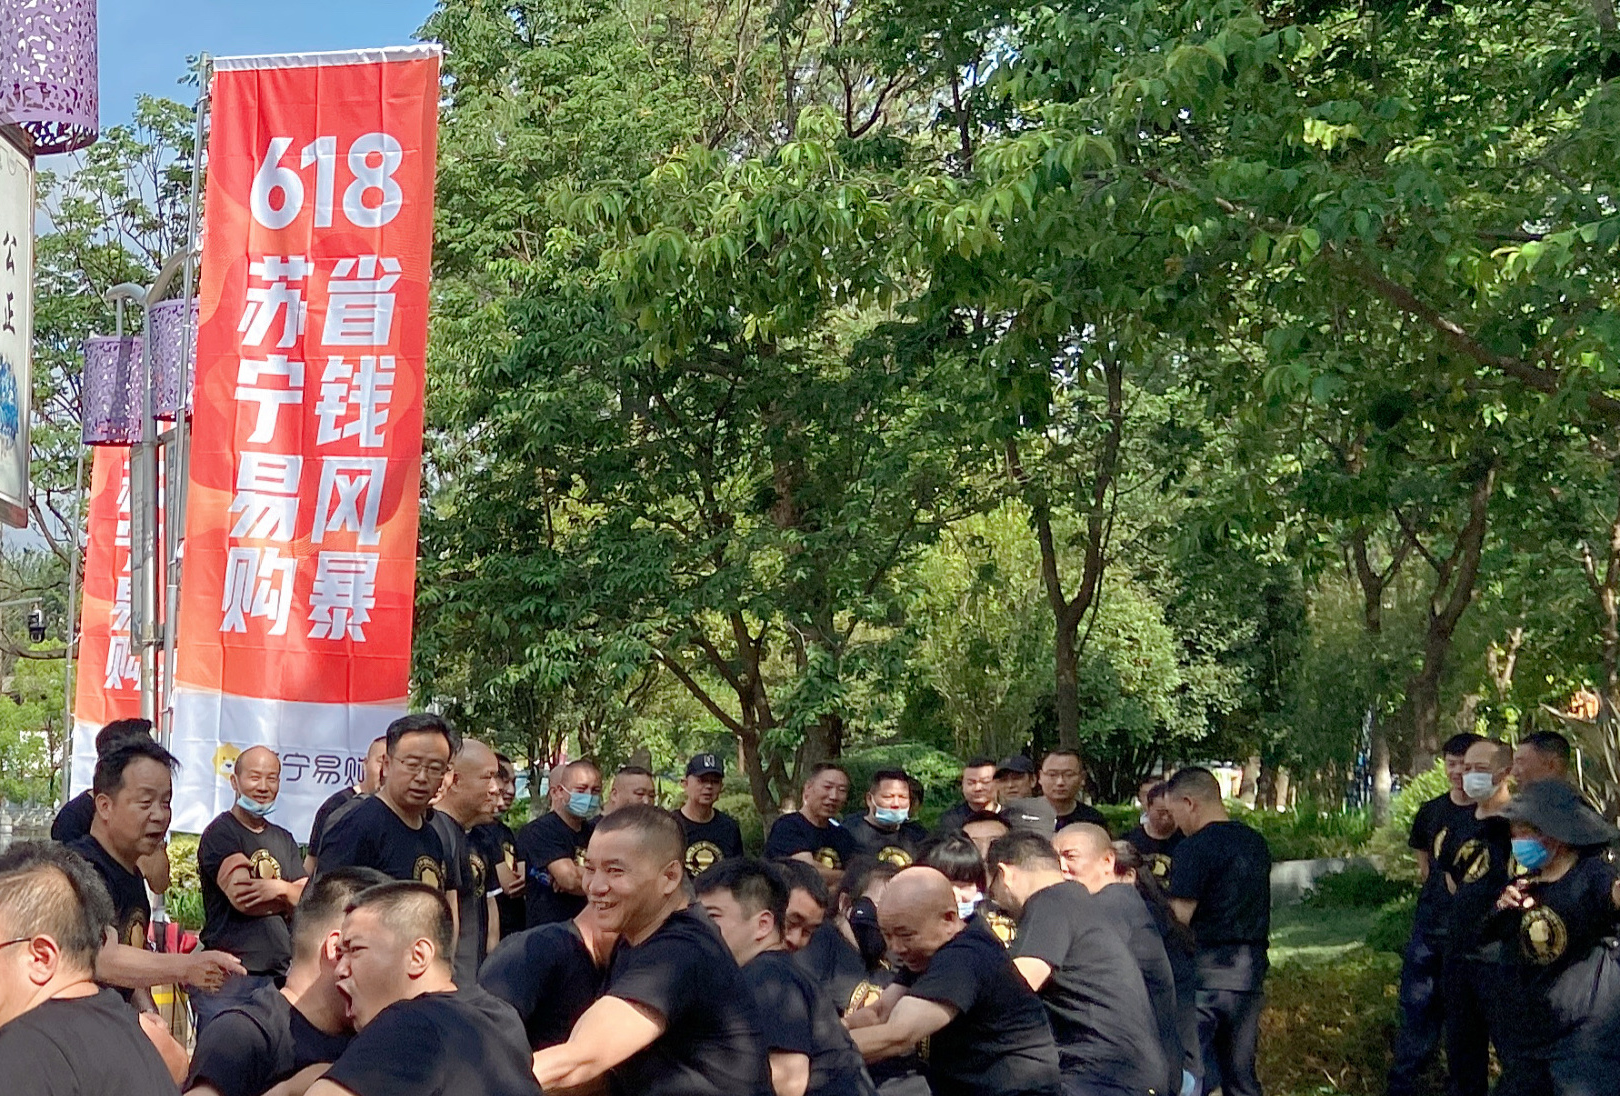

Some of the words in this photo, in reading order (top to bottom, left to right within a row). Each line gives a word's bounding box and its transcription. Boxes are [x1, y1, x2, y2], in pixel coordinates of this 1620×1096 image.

[250, 132, 403, 229] 618
[2, 231, 17, 335] 公正
[220, 255, 315, 636] 苏宁易购
[307, 254, 403, 642] 省钱风暴
[276, 752, 366, 786] 宁易购
